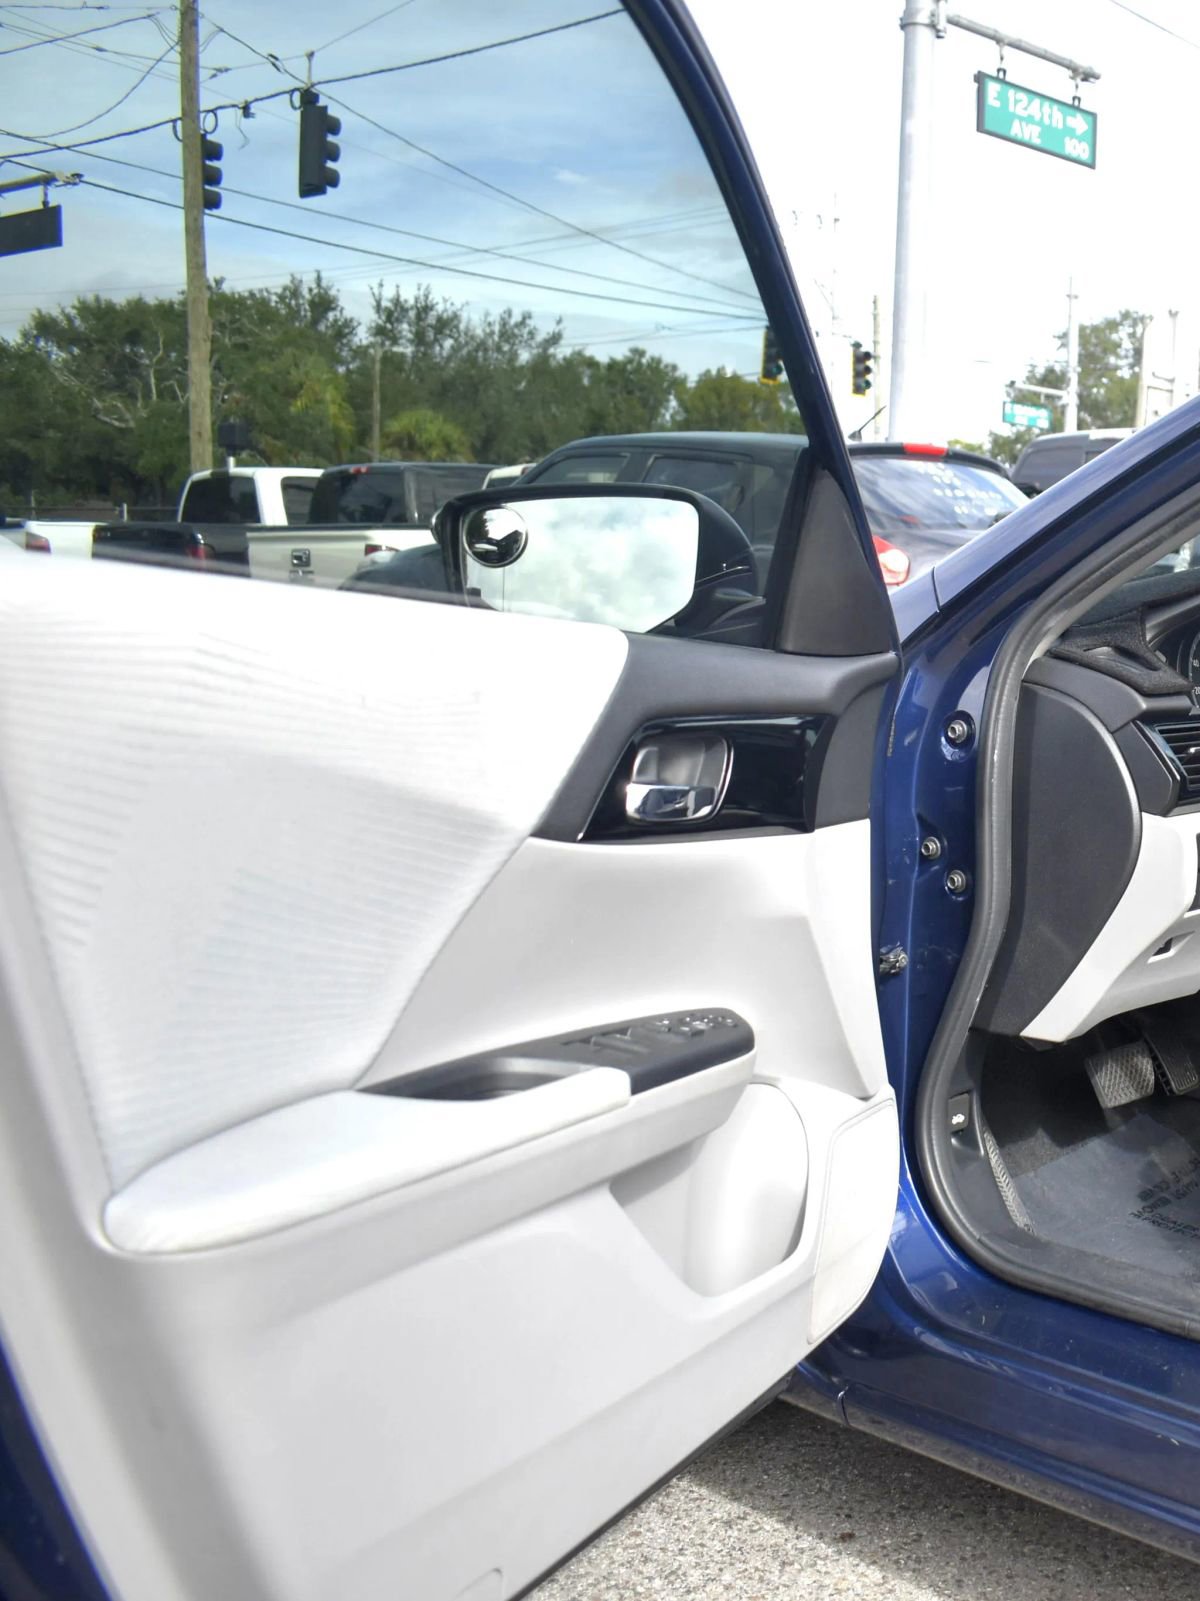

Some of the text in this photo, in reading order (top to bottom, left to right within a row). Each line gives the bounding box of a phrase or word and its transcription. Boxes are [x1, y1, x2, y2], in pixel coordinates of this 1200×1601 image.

[987, 81, 1064, 130] E 124th
[1010, 118, 1042, 145] AVE
